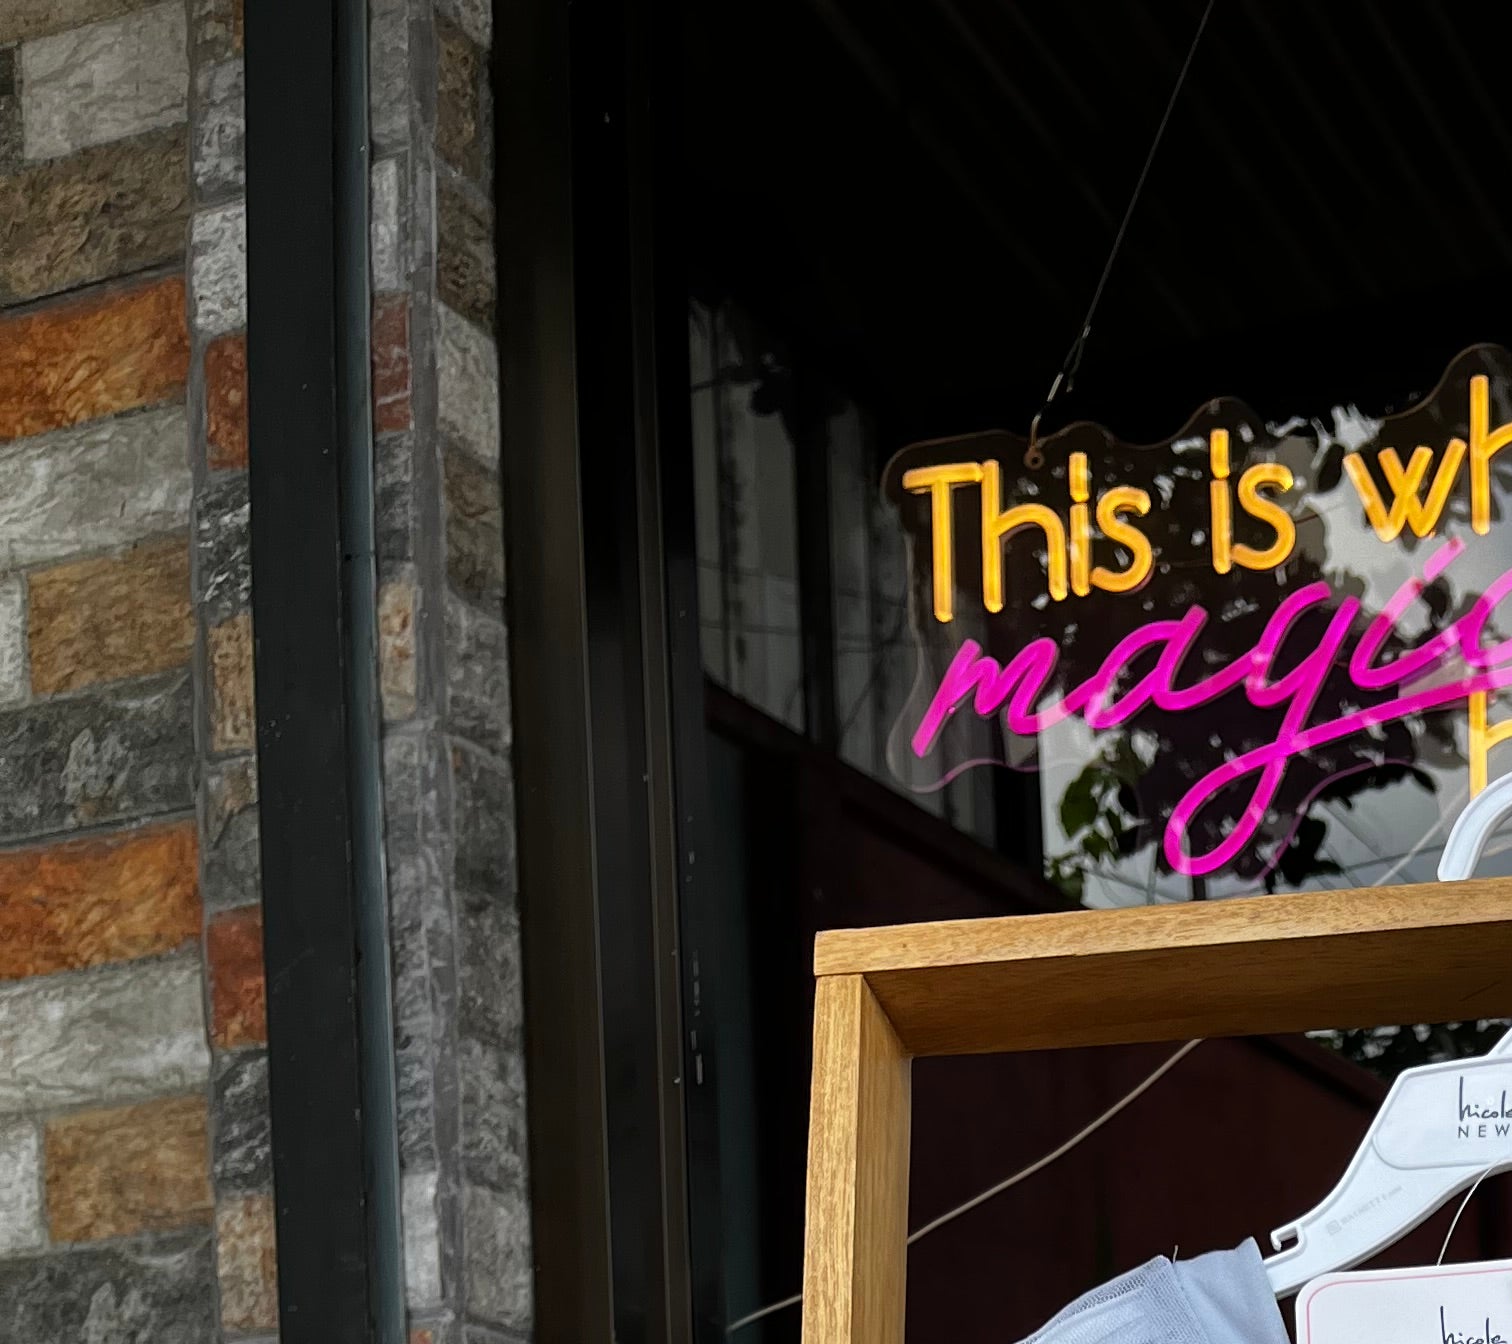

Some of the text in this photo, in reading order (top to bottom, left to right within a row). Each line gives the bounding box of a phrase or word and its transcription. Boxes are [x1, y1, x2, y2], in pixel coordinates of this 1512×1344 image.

[903, 448, 1153, 623] This
[1209, 428, 1296, 575] is
[1458, 1124, 1510, 1138] NEW
